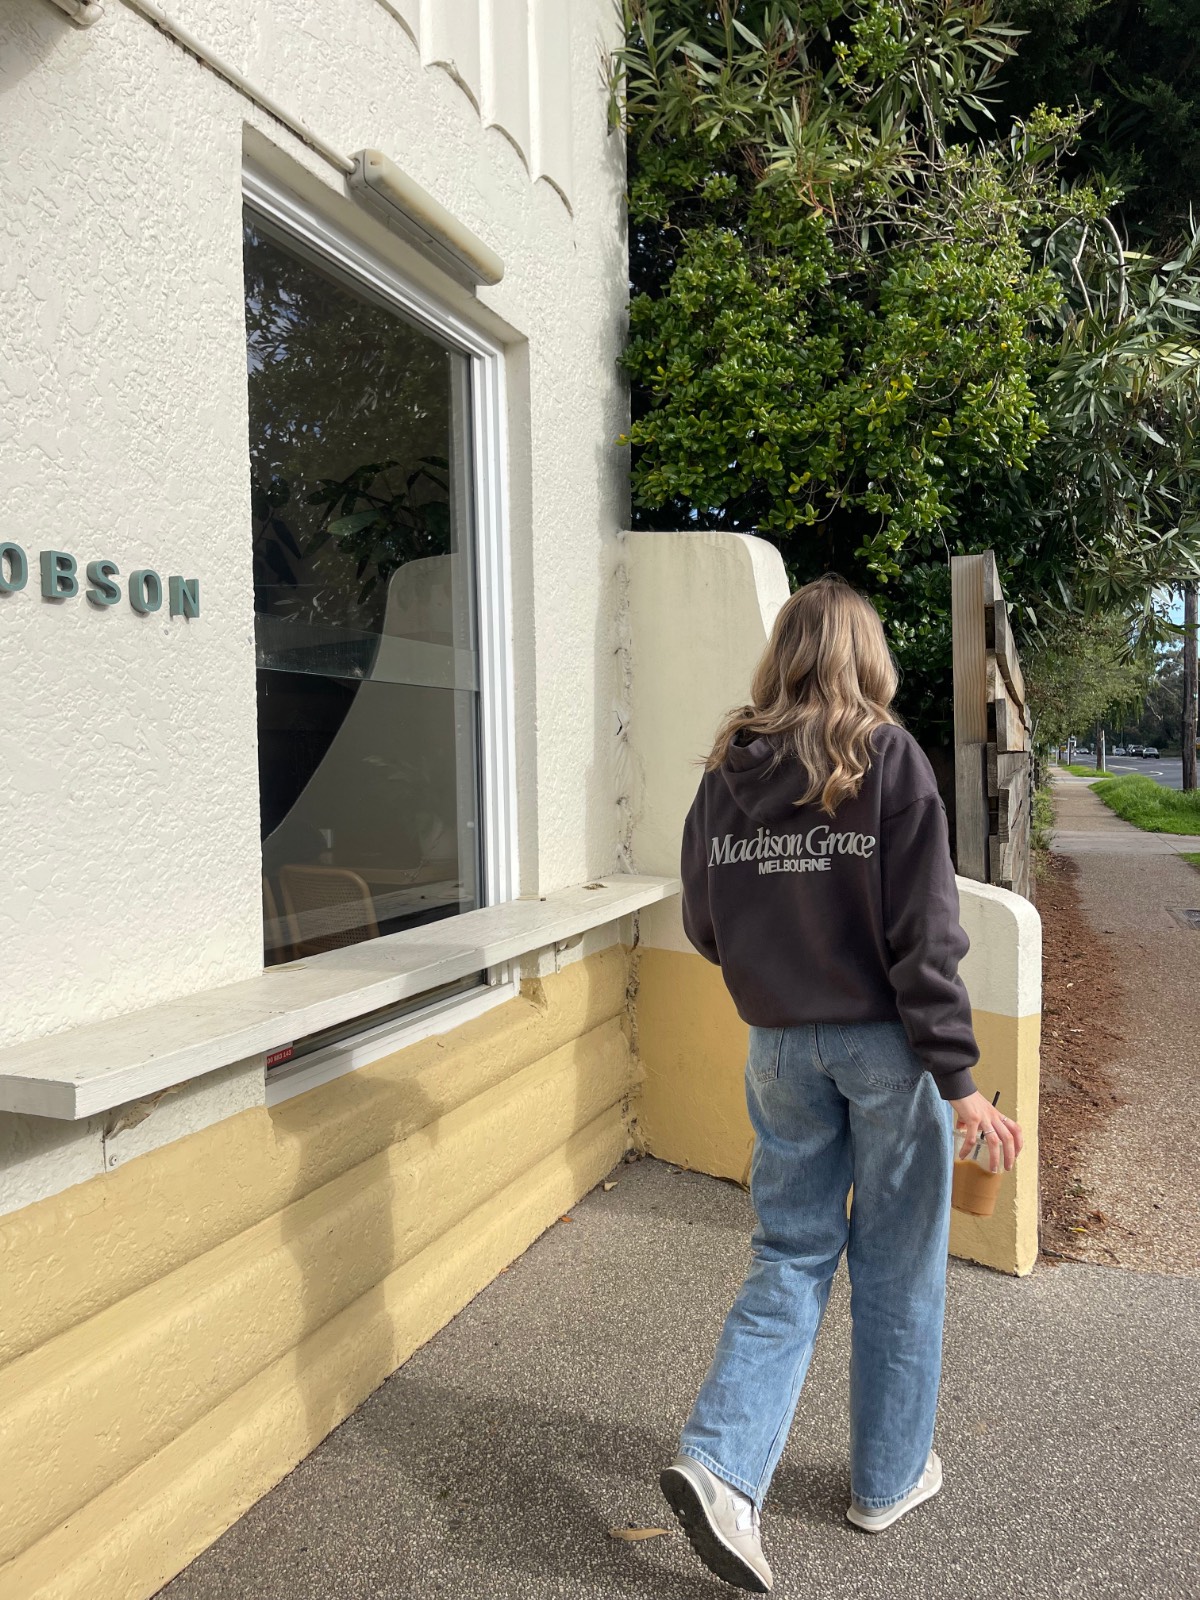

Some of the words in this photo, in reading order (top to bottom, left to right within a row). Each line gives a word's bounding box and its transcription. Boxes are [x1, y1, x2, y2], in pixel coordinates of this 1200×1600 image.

[0, 541, 200, 618] OBSON
[708, 827, 803, 867] Madison
[805, 825, 876, 858] Grace
[758, 858, 832, 875] MELBOURNE
